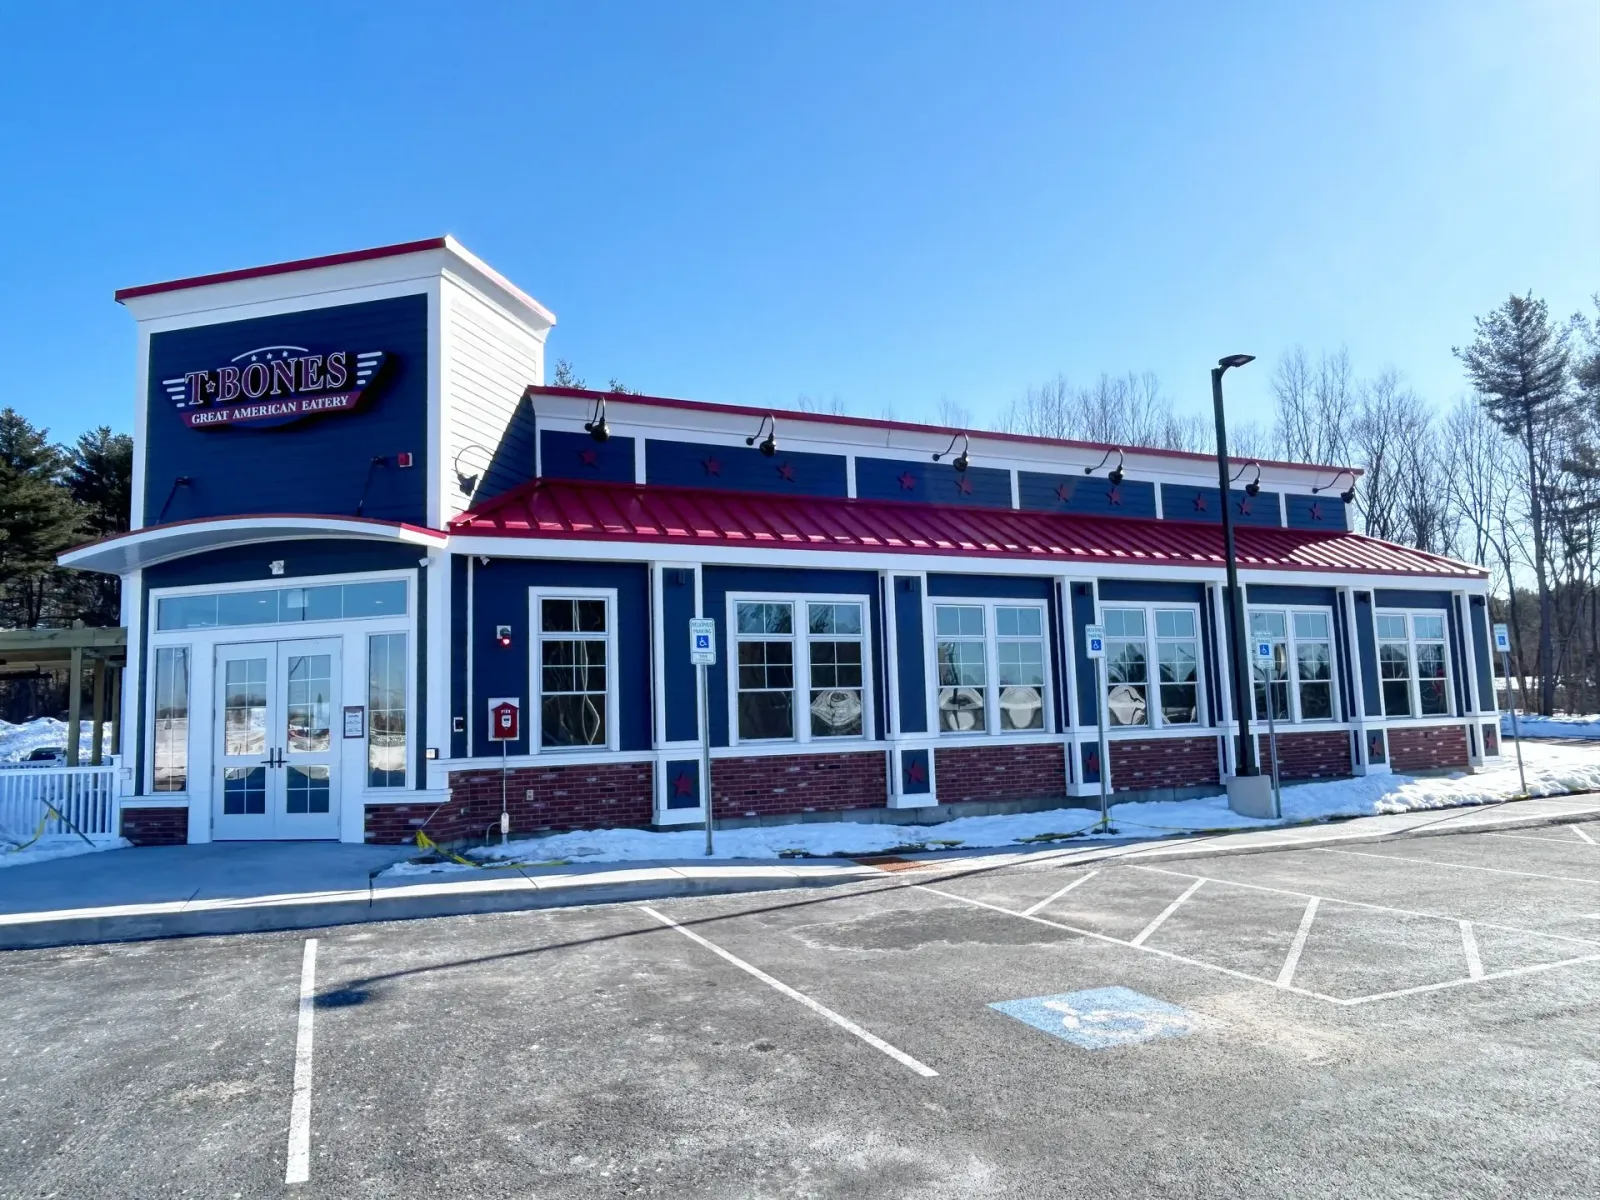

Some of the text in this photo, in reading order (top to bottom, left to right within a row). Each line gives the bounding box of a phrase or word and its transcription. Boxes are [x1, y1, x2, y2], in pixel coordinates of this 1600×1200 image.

[191, 395, 349, 424] GREAT AMERICAN EATERY
